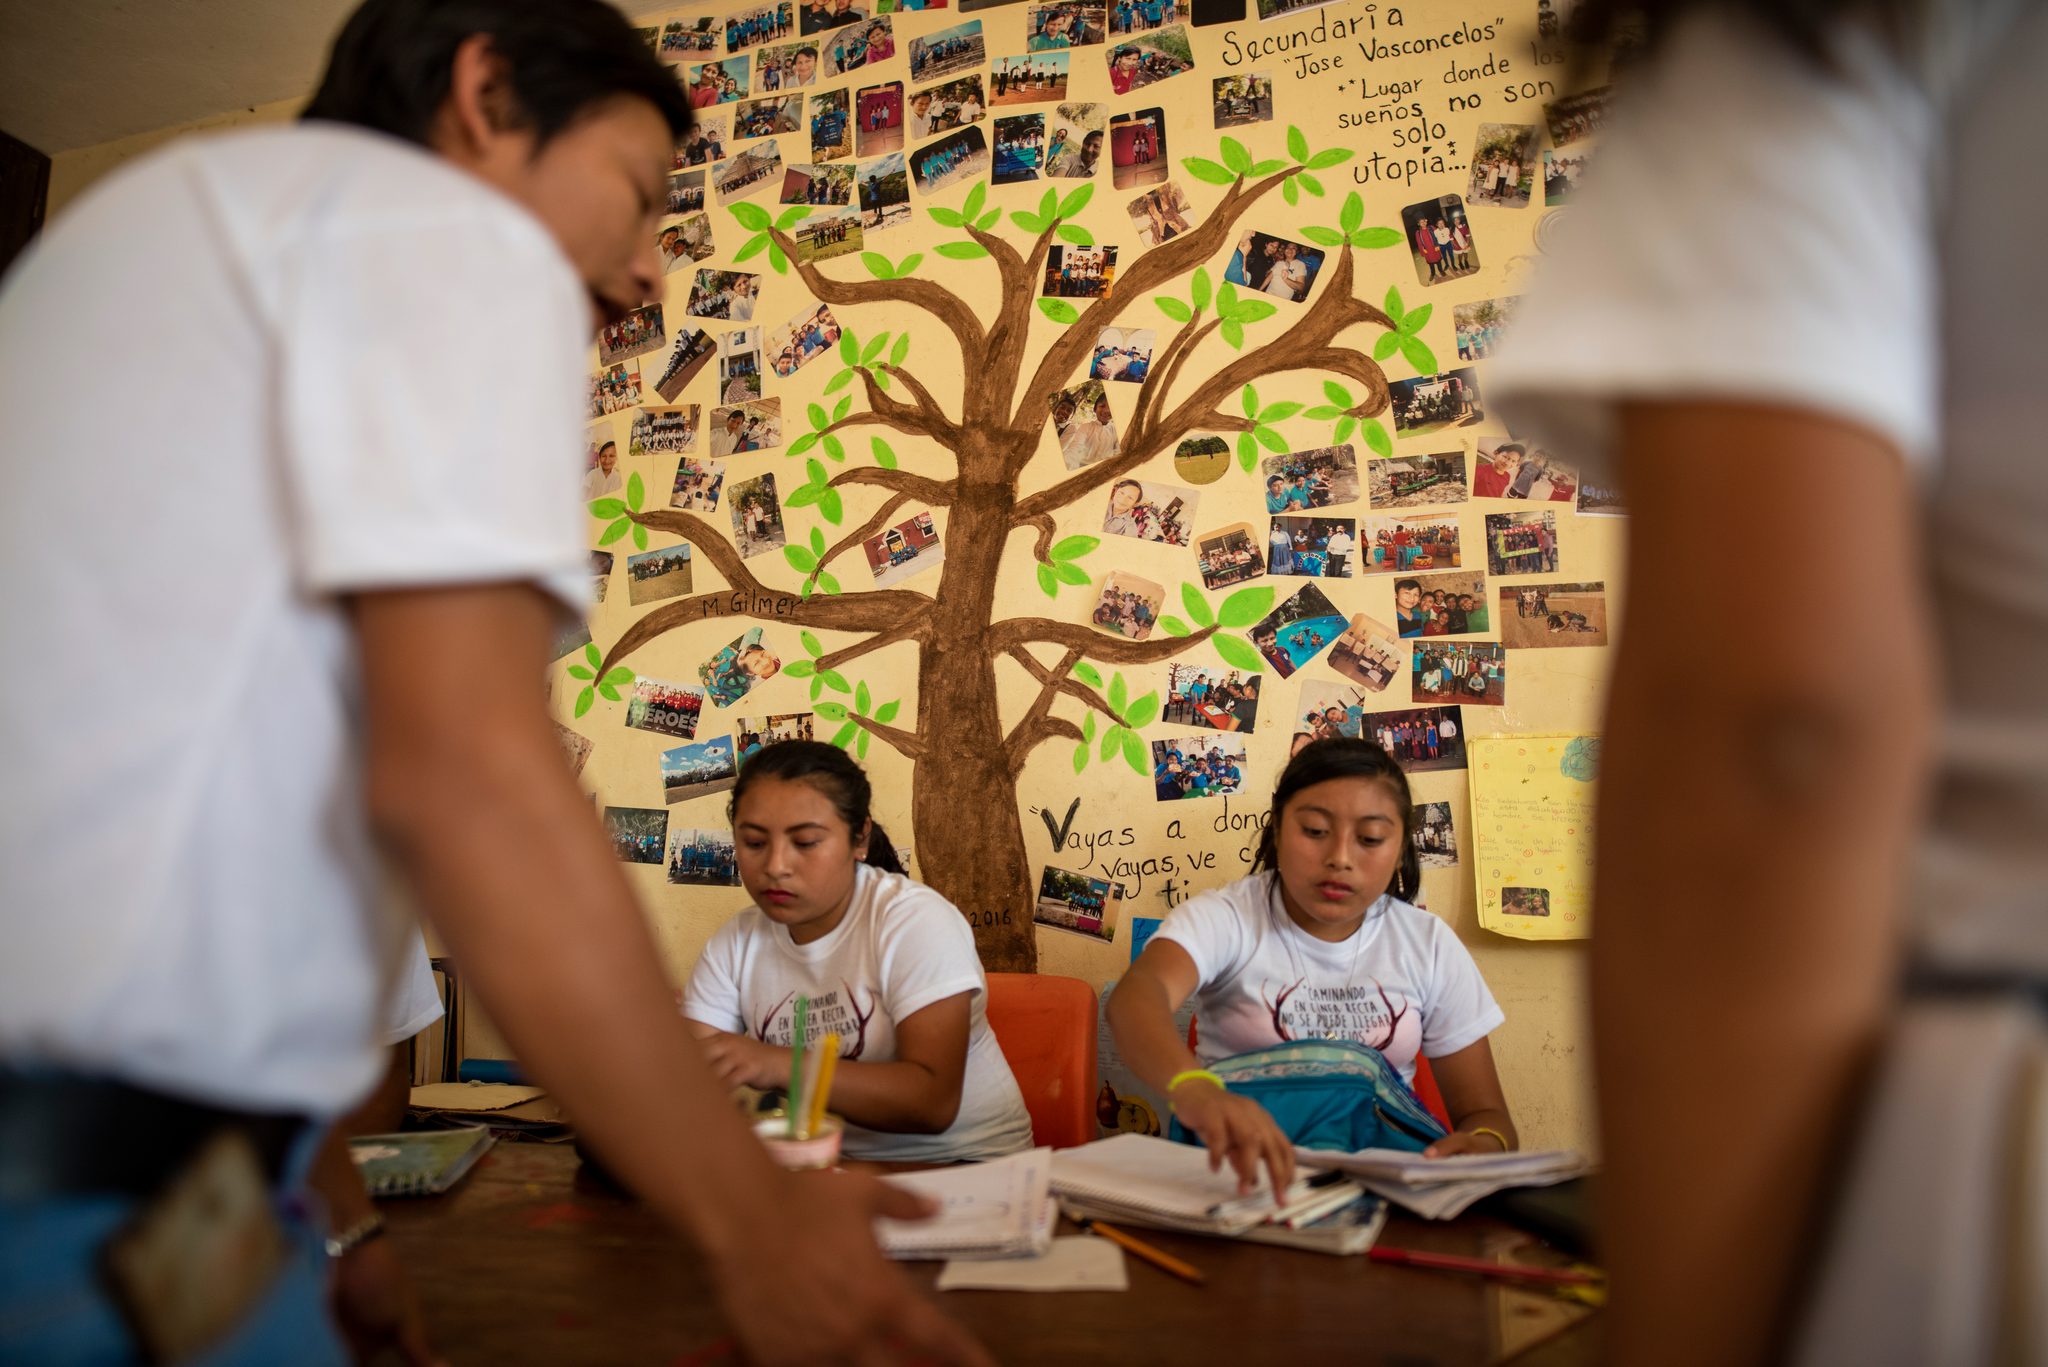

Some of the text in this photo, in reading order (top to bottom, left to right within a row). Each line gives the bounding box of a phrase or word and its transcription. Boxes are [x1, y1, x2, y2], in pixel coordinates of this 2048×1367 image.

[1223, 4, 1403, 66] Secundaria
[1443, 52, 1510, 85] donde
[1531, 41, 1566, 67] los
[1338, 79, 1556, 129] sueños no son
[1392, 117, 1447, 148] solo
[703, 588, 804, 618] M. Gilmer
[1166, 819, 1186, 840] a
[1213, 795, 1273, 833] dond
[1101, 854, 1180, 899] vayas,
[1187, 850, 1216, 870] ve
[969, 908, 1012, 928] 2016
[778, 1016, 790, 1032] EN
[821, 1005, 847, 1024] RECTA
[1281, 1012, 1295, 1025] NO
[1299, 1013, 1311, 1028] SE
[1317, 1013, 1347, 1030] PUEDE
[780, 1031, 792, 1048] SE
